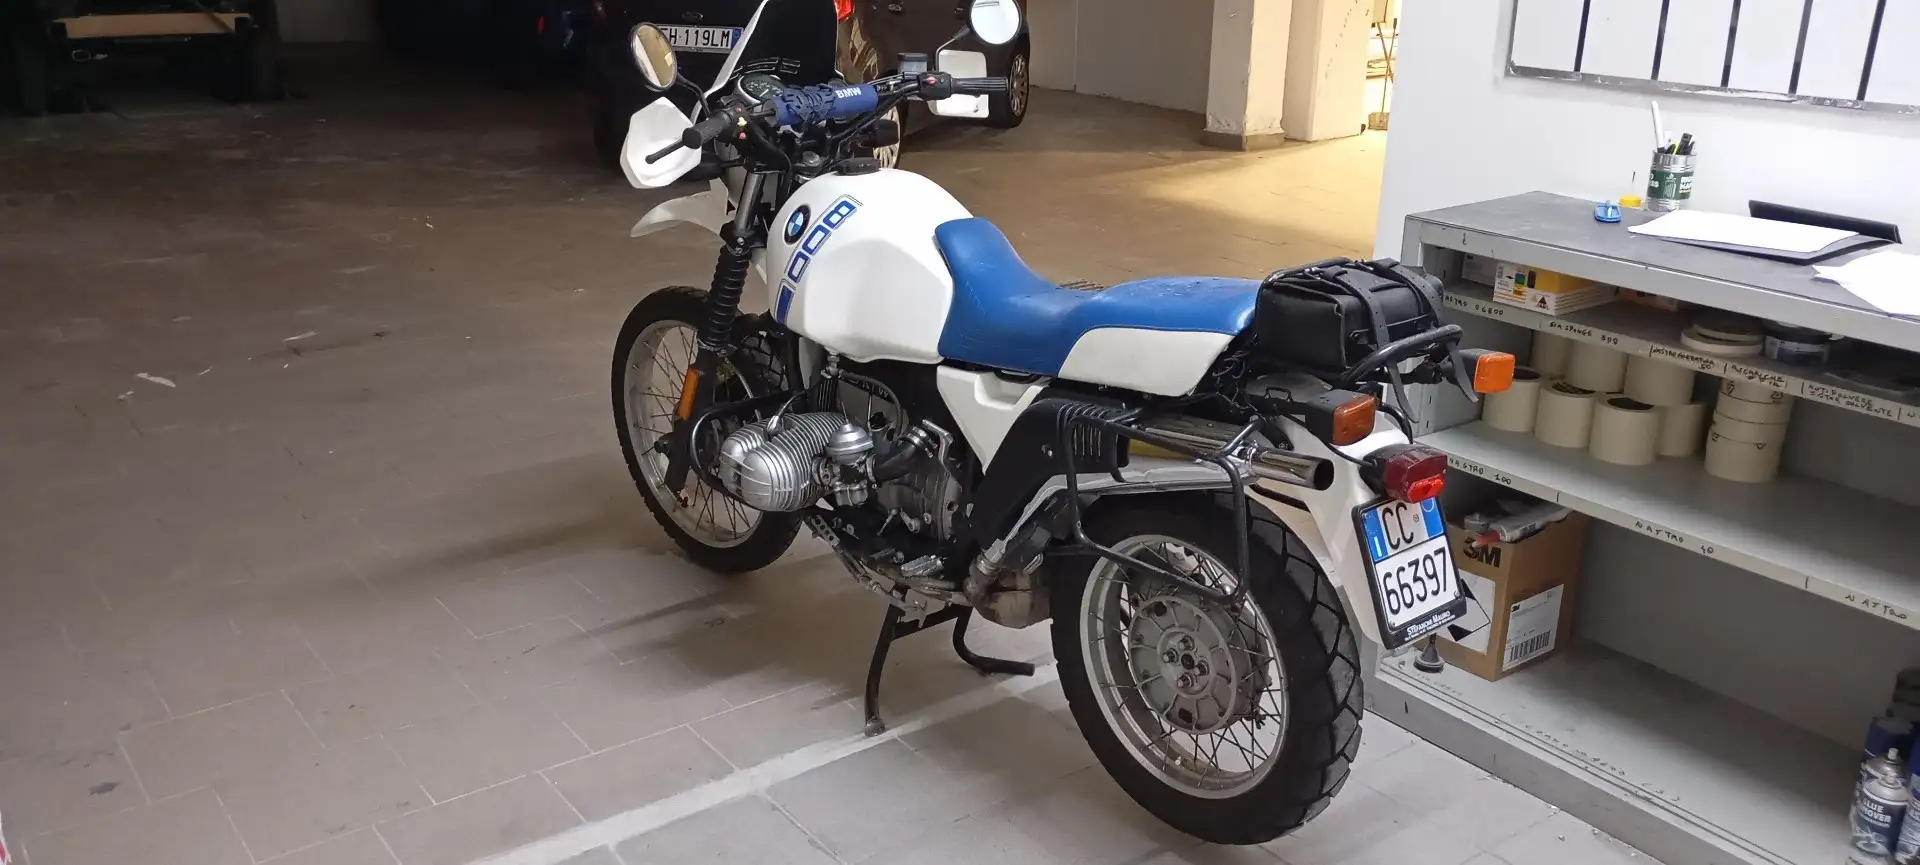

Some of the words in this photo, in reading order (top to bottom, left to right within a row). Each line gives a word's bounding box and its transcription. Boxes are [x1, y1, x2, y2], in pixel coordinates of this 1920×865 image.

[661, 27, 678, 45] H
[835, 86, 862, 98] BMW
[784, 200, 858, 284] 800
[1444, 294, 1467, 307] ASTRO
[1494, 473, 1512, 485] 100
[1382, 502, 1414, 550] CC
[1463, 536, 1501, 568] 3M
[1383, 546, 1447, 615] 66397
